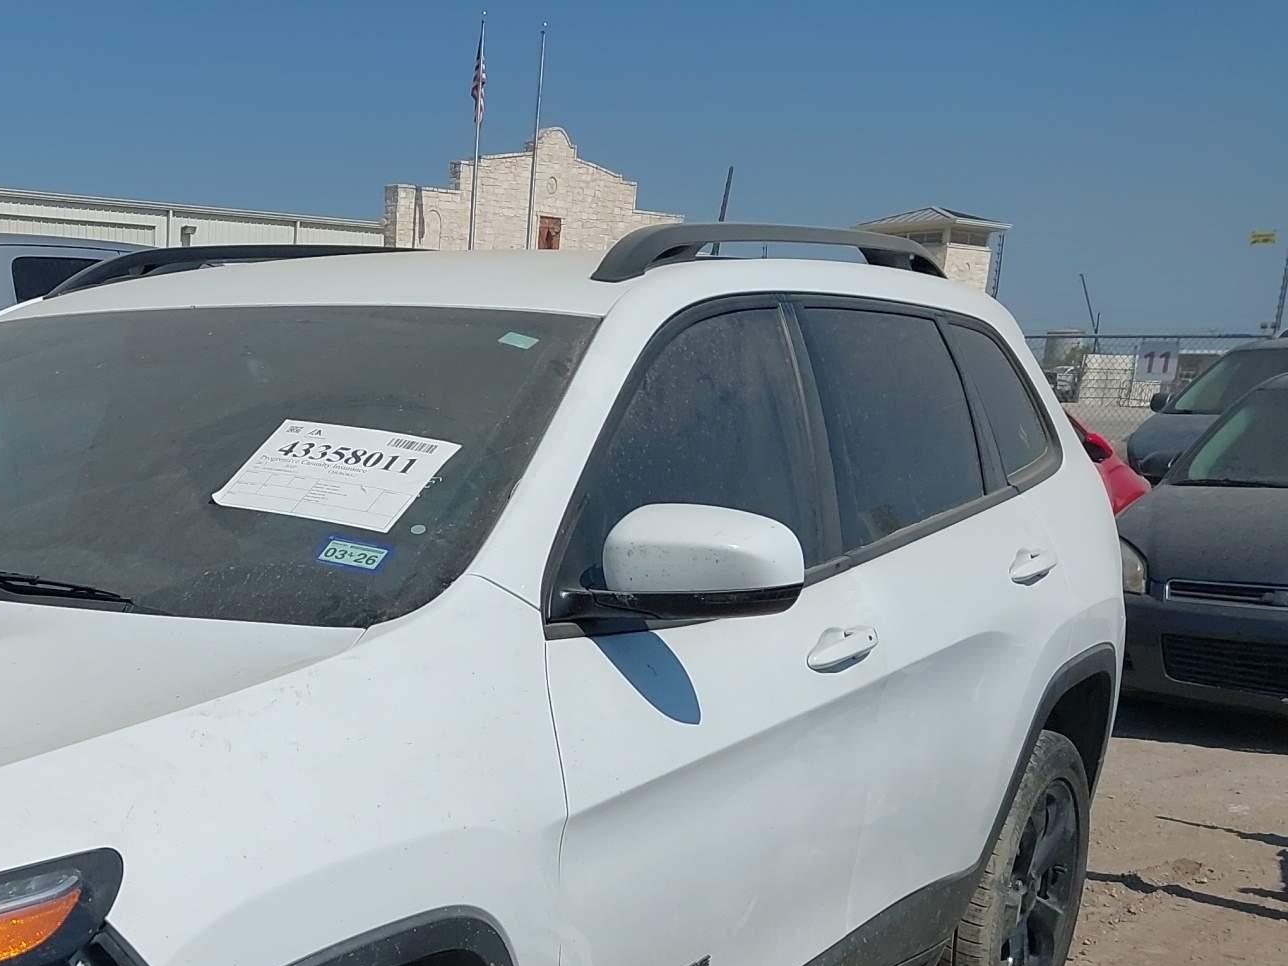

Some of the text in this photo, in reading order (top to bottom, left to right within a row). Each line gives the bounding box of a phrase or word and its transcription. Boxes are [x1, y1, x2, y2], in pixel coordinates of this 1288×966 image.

[1144, 351, 1171, 374] 11
[278, 440, 417, 475] 43358011
[324, 547, 348, 560] 03
[353, 552, 379, 566] 26
